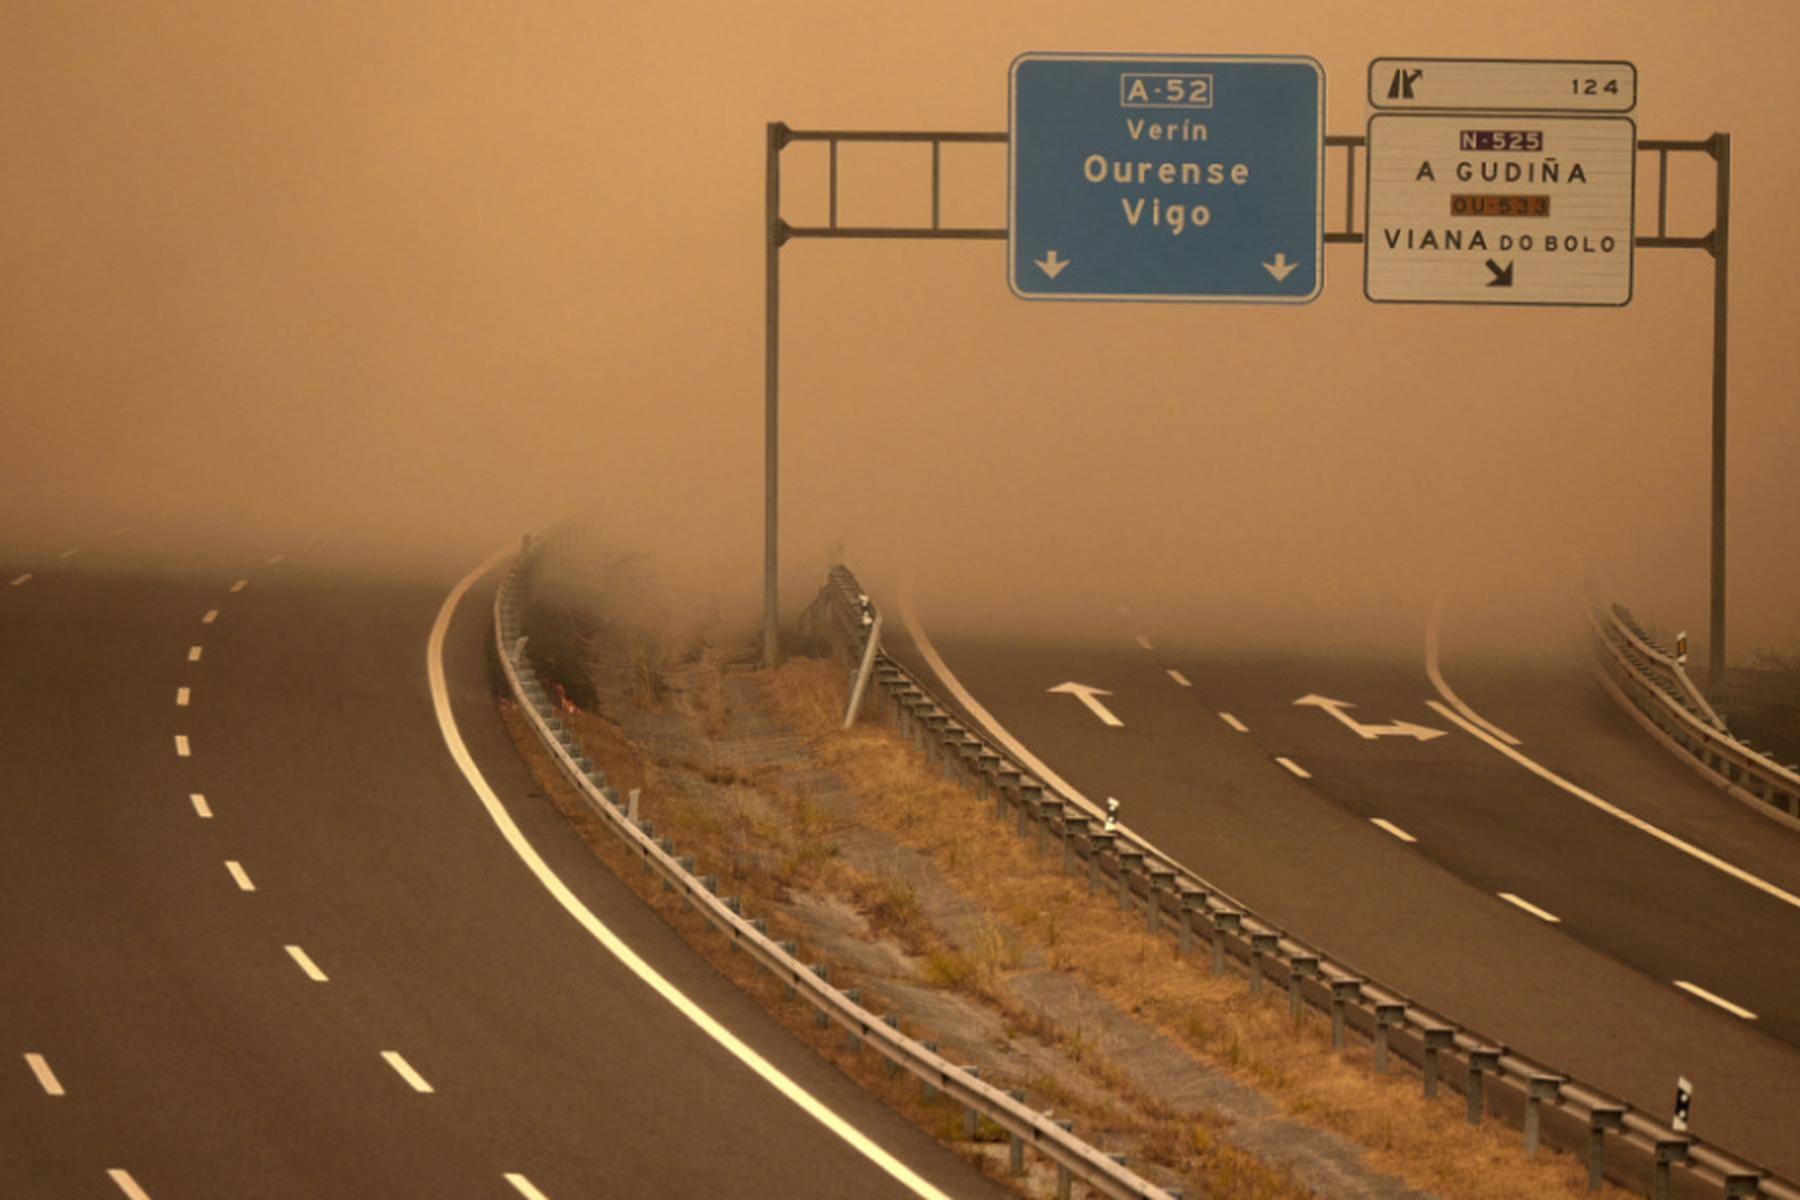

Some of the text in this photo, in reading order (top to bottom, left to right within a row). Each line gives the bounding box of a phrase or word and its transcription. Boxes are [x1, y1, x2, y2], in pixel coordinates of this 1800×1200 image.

[1127, 79, 1208, 102] A-52
[1571, 79, 1619, 95] 124
[1126, 118, 1208, 141] Verín
[1462, 133, 1541, 150] N-525
[1083, 154, 1250, 185] Ourense
[1416, 157, 1587, 184] A GUDIÑA
[1121, 197, 1211, 236] Vigo
[1453, 198, 1547, 215] OU-533
[1384, 228, 1615, 252] VIANA DO BOLO
